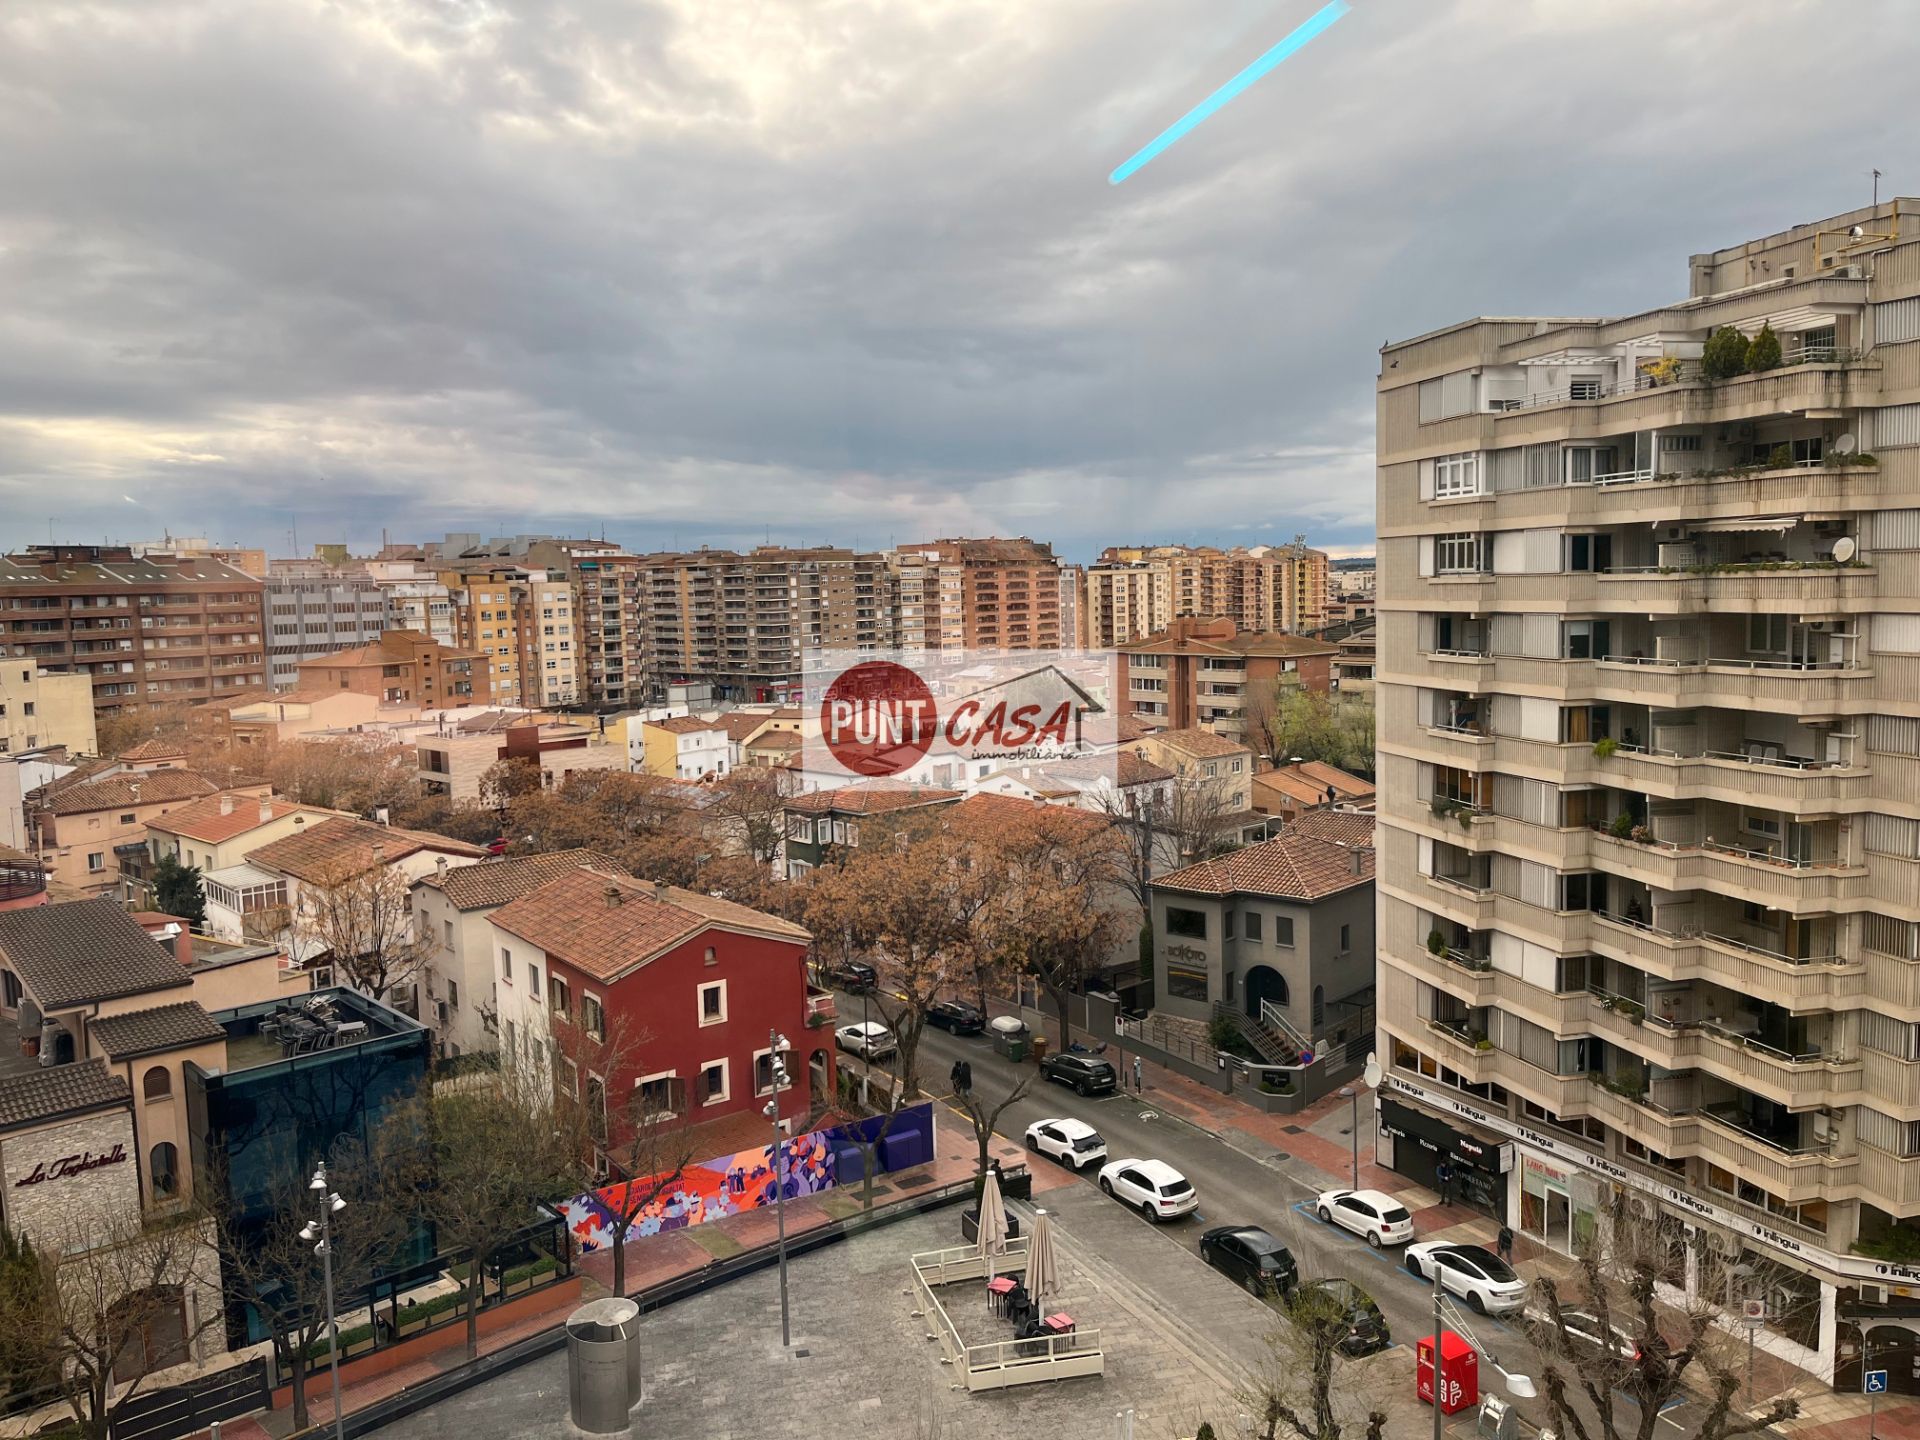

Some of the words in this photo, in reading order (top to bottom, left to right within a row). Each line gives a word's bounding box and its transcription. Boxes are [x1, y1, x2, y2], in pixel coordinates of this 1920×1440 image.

[1401, 1081, 1424, 1097] inlingua
[1460, 1104, 1486, 1121] inlingua
[1526, 1130, 1554, 1149] inlingua
[15, 1162, 46, 1187] La
[47, 1143, 128, 1180] Tagliatella
[1596, 1158, 1627, 1179] inlingua
[1680, 1193, 1713, 1215] inlingua
[1763, 1228, 1800, 1251] inlingua
